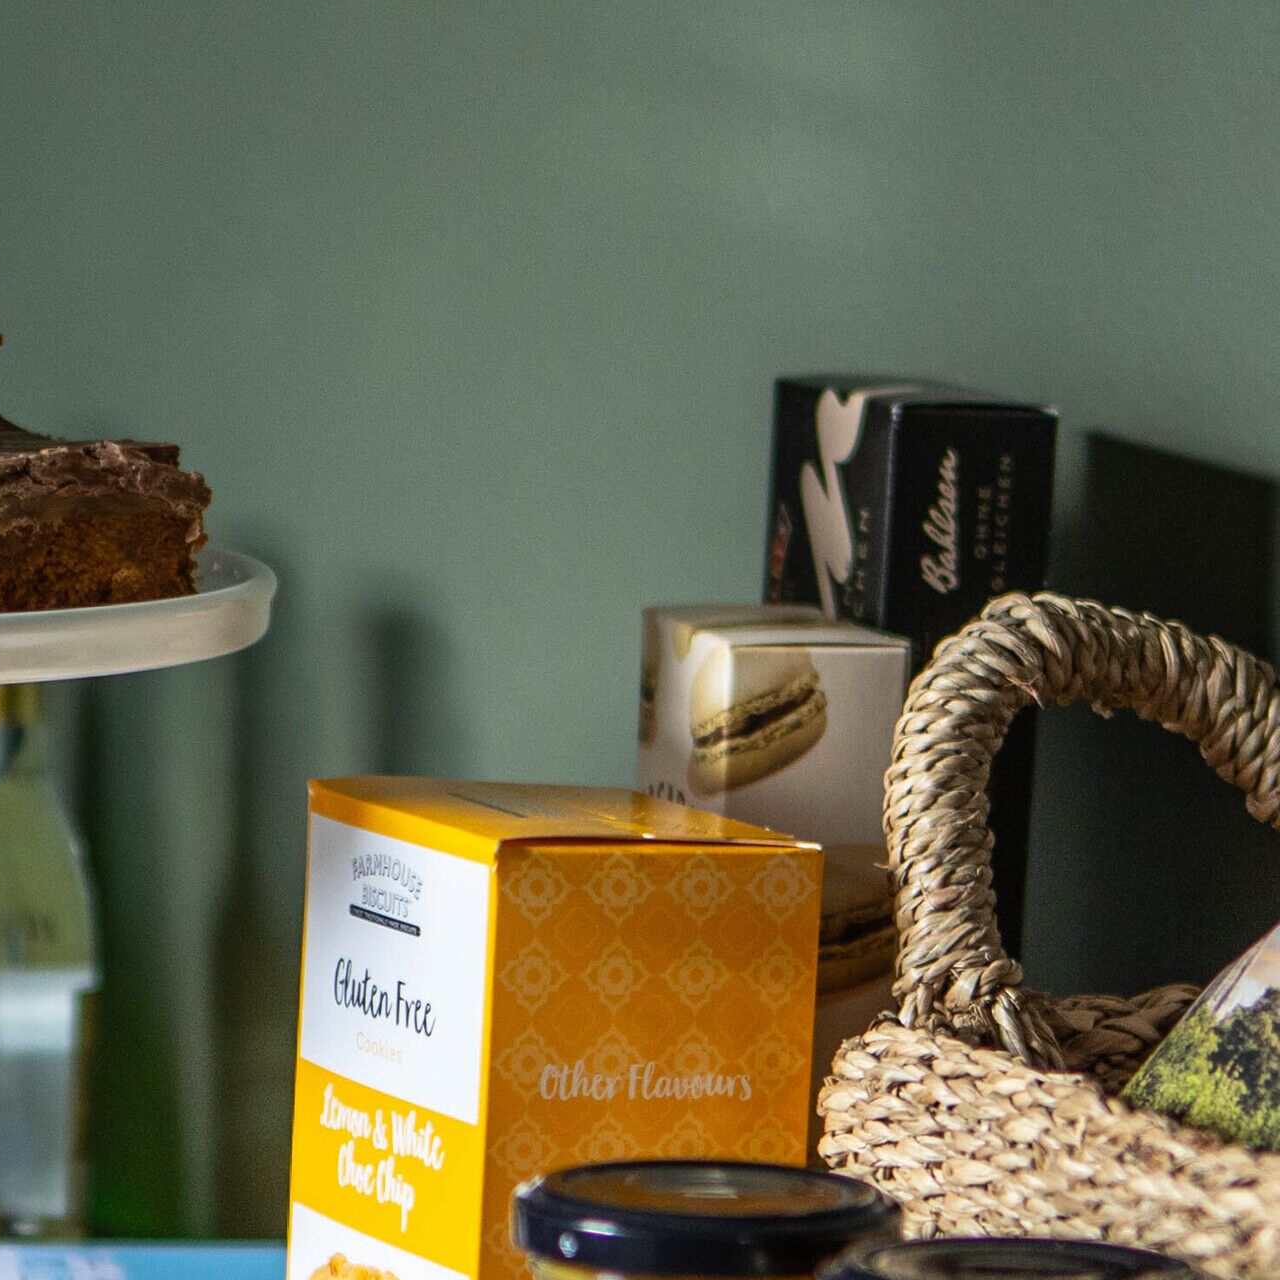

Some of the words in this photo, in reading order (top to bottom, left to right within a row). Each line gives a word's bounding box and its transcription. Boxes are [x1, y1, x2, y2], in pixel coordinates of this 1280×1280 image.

[921, 447, 958, 594] Bahlsen
[351, 853, 424, 901] FARMHOUSE
[360, 883, 412, 918] BISCUITS
[333, 957, 392, 1019] Gluten
[395, 980, 437, 1037] Free
[356, 1031, 402, 1064] Cookies
[539, 1058, 623, 1101] Other
[626, 1061, 753, 1101] Flavours
[319, 1082, 372, 1139] Lemon
[372, 1108, 389, 1150] &
[391, 1110, 446, 1171] White
[337, 1140, 375, 1196] Choc
[376, 1155, 416, 1233] Chip
